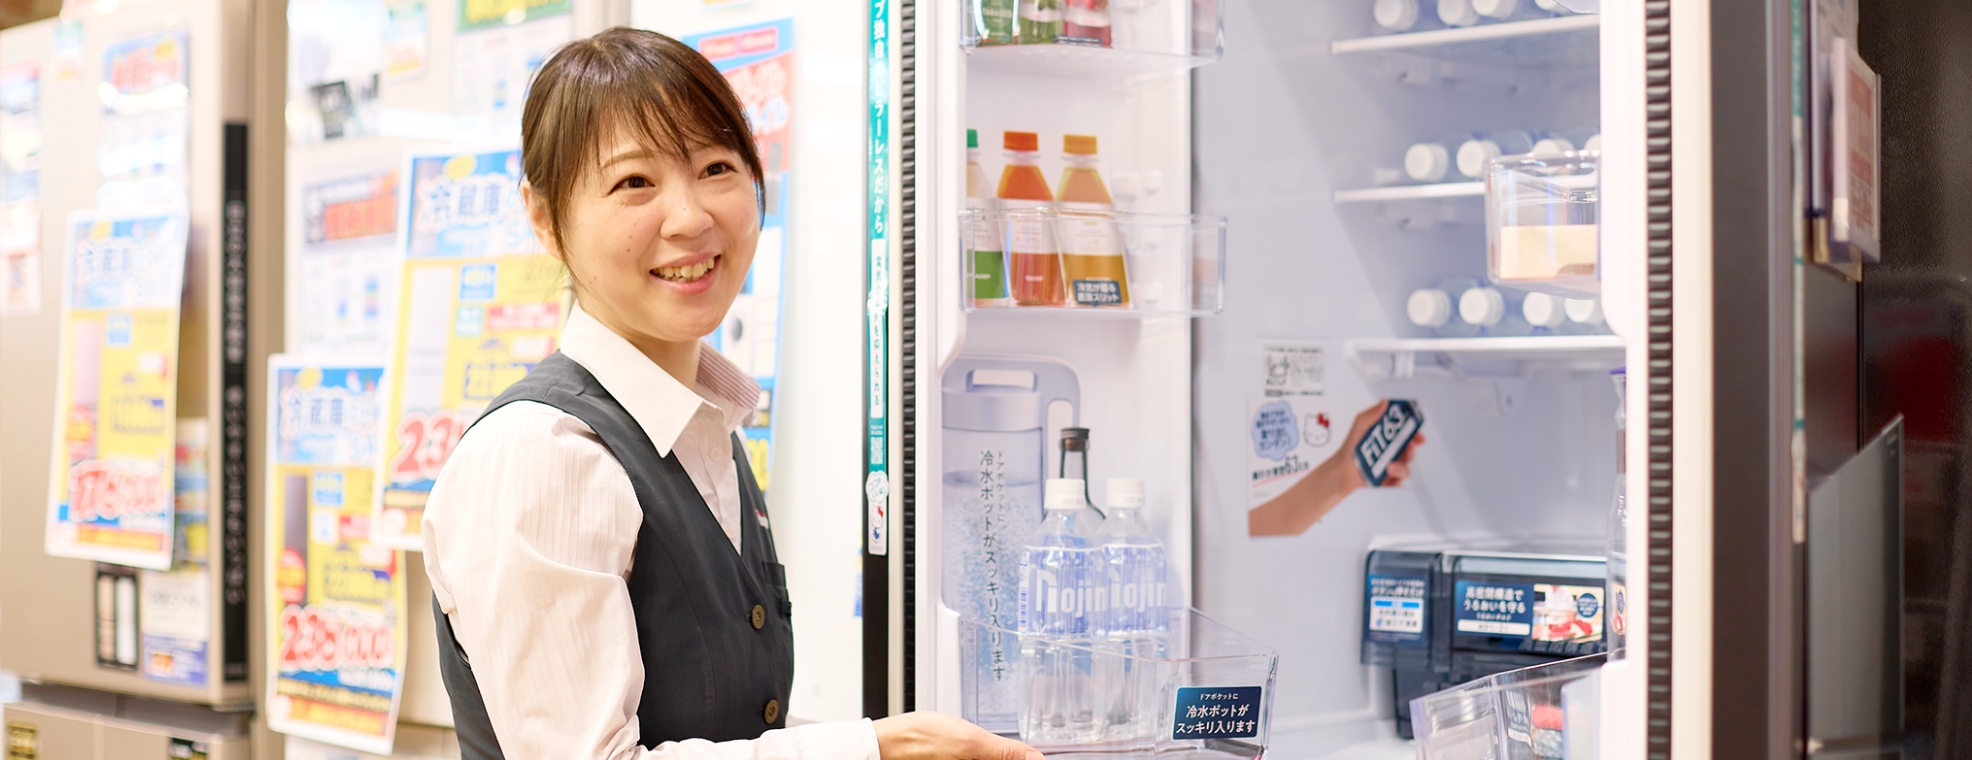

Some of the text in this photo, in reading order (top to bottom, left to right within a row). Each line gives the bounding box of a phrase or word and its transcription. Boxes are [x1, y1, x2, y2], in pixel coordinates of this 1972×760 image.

[979, 450, 1005, 682] 冷水ポットがスッキリ入ります
[1463, 599, 1527, 615] うるおいを守る
[1200, 693, 1239, 701] ドアポケットに
[1186, 703, 1250, 719] 冷水ポットが
[1176, 720, 1256, 734] スッキリ入ります
